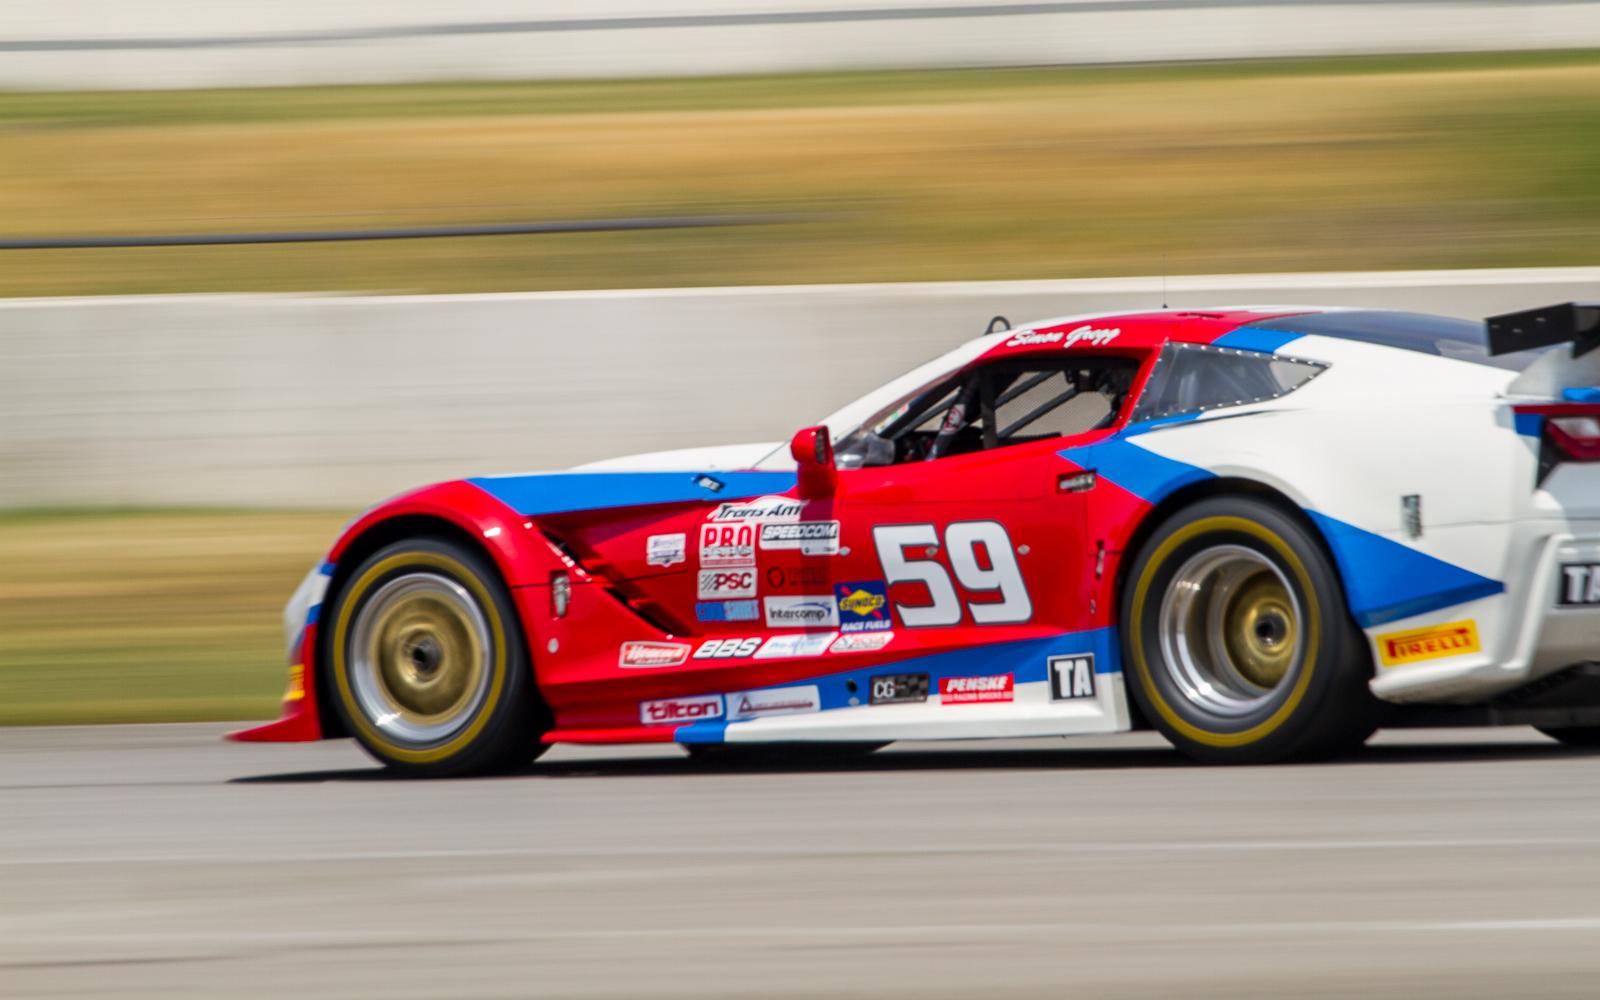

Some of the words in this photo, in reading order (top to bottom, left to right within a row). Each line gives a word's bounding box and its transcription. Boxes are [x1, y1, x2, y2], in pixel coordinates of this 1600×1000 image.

[1006, 328, 1064, 346] Simon
[719, 504, 764, 519] Trans
[766, 502, 800, 517] Am
[762, 524, 837, 540] SPEEDCOM
[714, 572, 752, 591] PSC
[872, 519, 1033, 628] 59
[839, 594, 885, 611] SUNOCO
[693, 637, 761, 658] BBS
[1385, 627, 1472, 659] PIRELLI
[946, 676, 1008, 692] PENSKE
[1054, 658, 1092, 698] TA
[874, 680, 895, 698] CG
